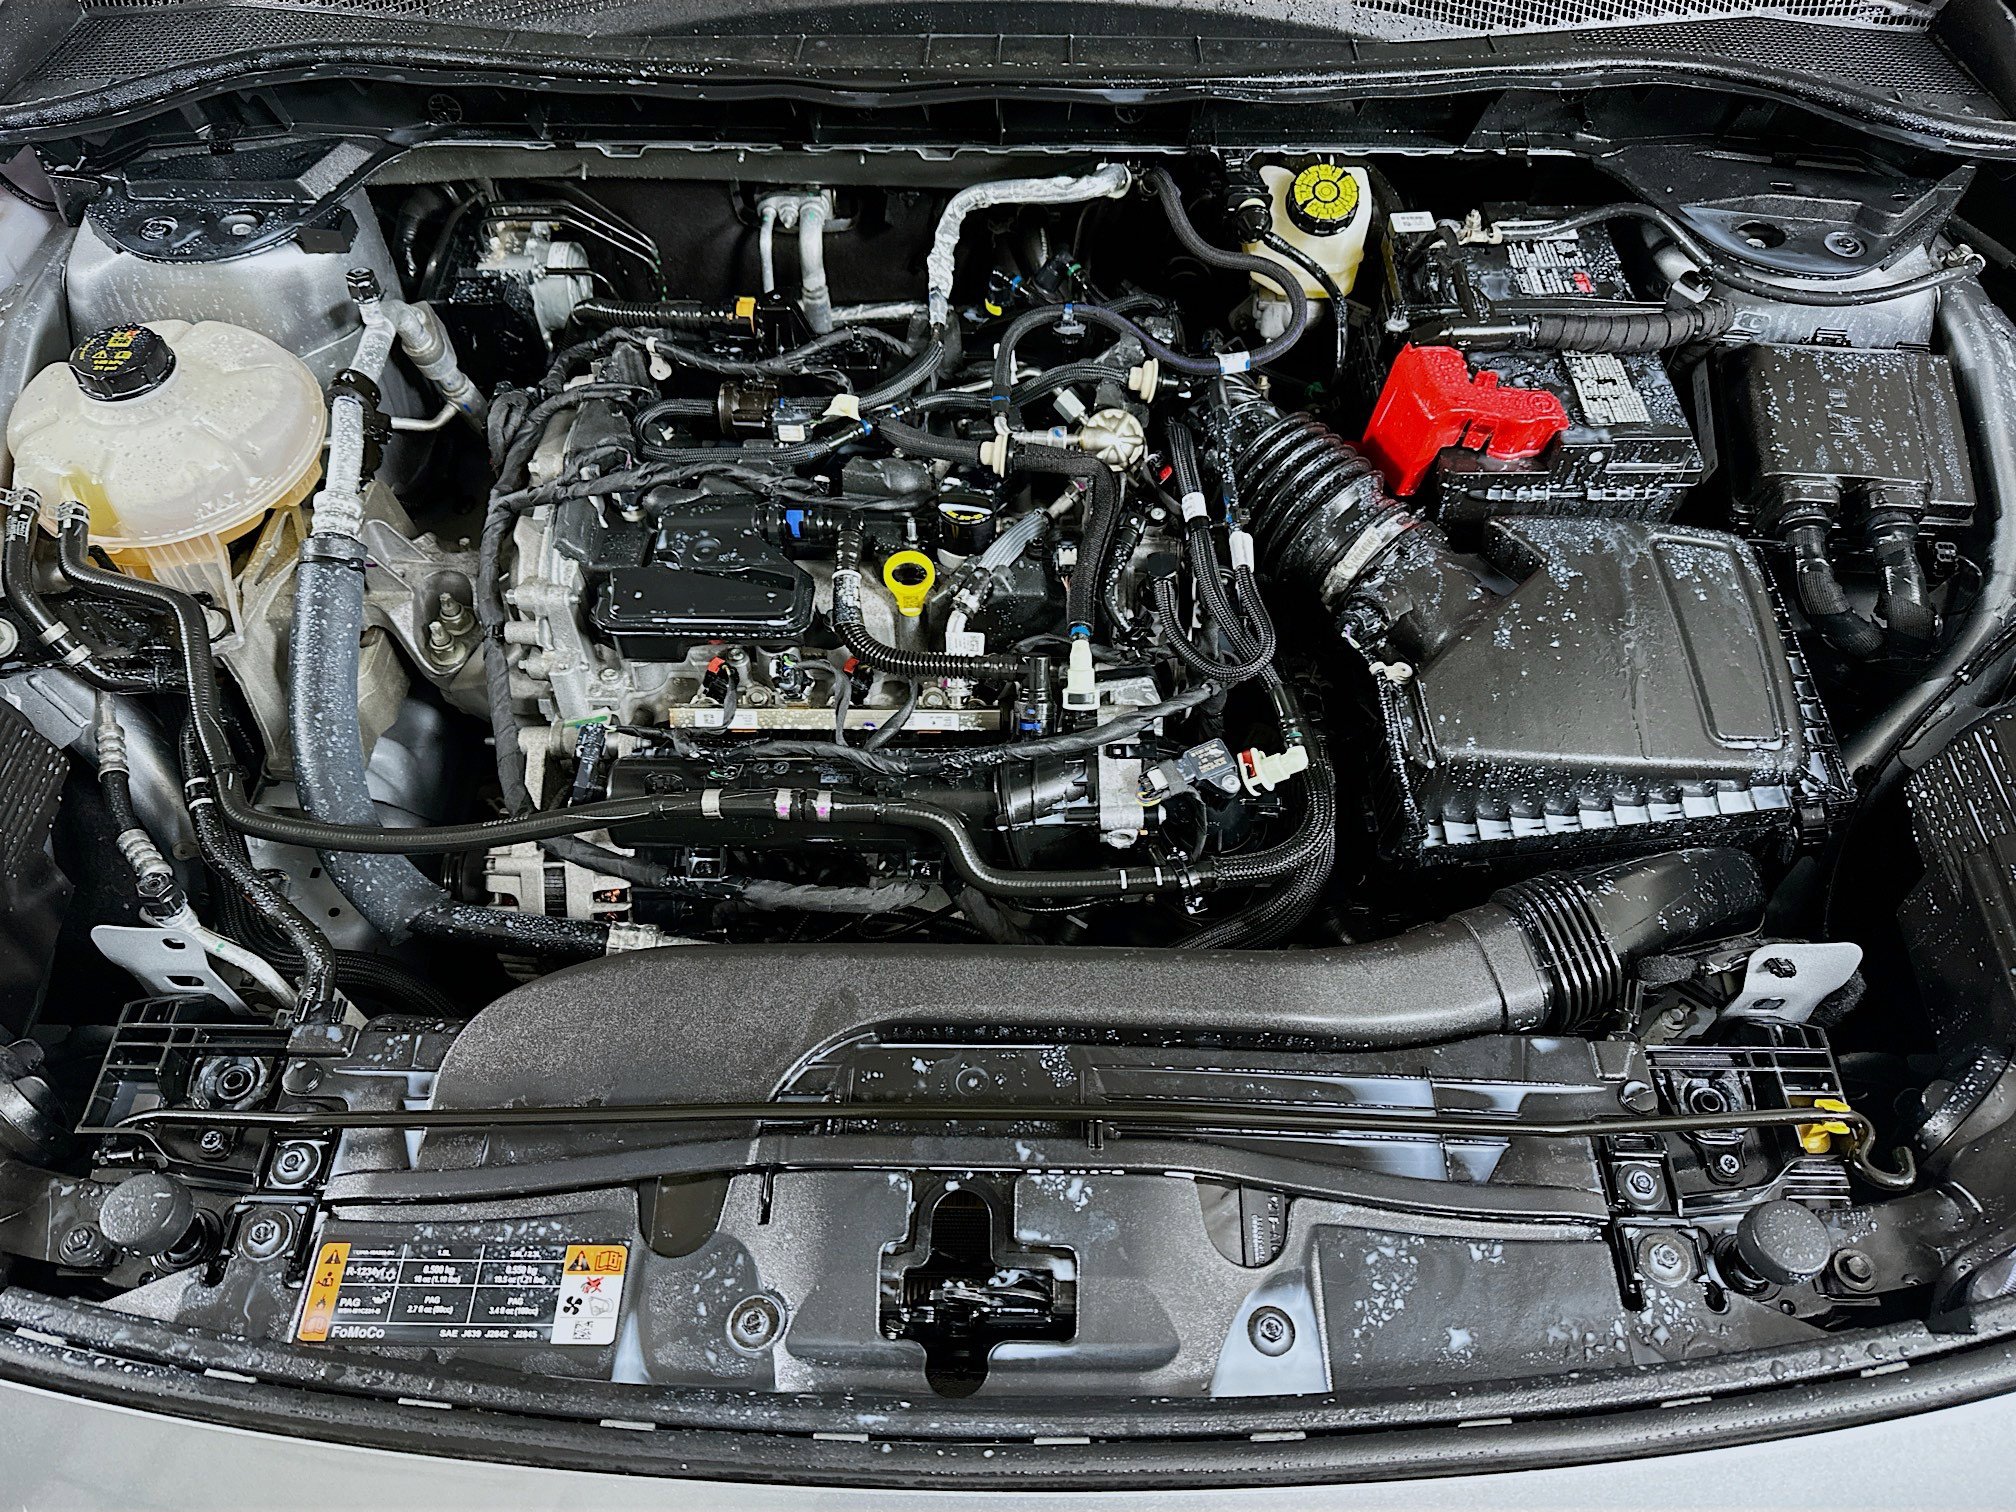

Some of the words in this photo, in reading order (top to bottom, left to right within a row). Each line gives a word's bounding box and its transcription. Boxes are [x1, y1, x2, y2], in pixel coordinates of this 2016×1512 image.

[444, 1264, 456, 1276] kg
[527, 1265, 539, 1277] kg
[339, 1297, 361, 1308] PAG
[424, 1295, 441, 1305] PAG
[507, 1297, 524, 1306] PAG
[330, 1325, 386, 1339] FoMoCo
[439, 1328, 459, 1338] SAE
